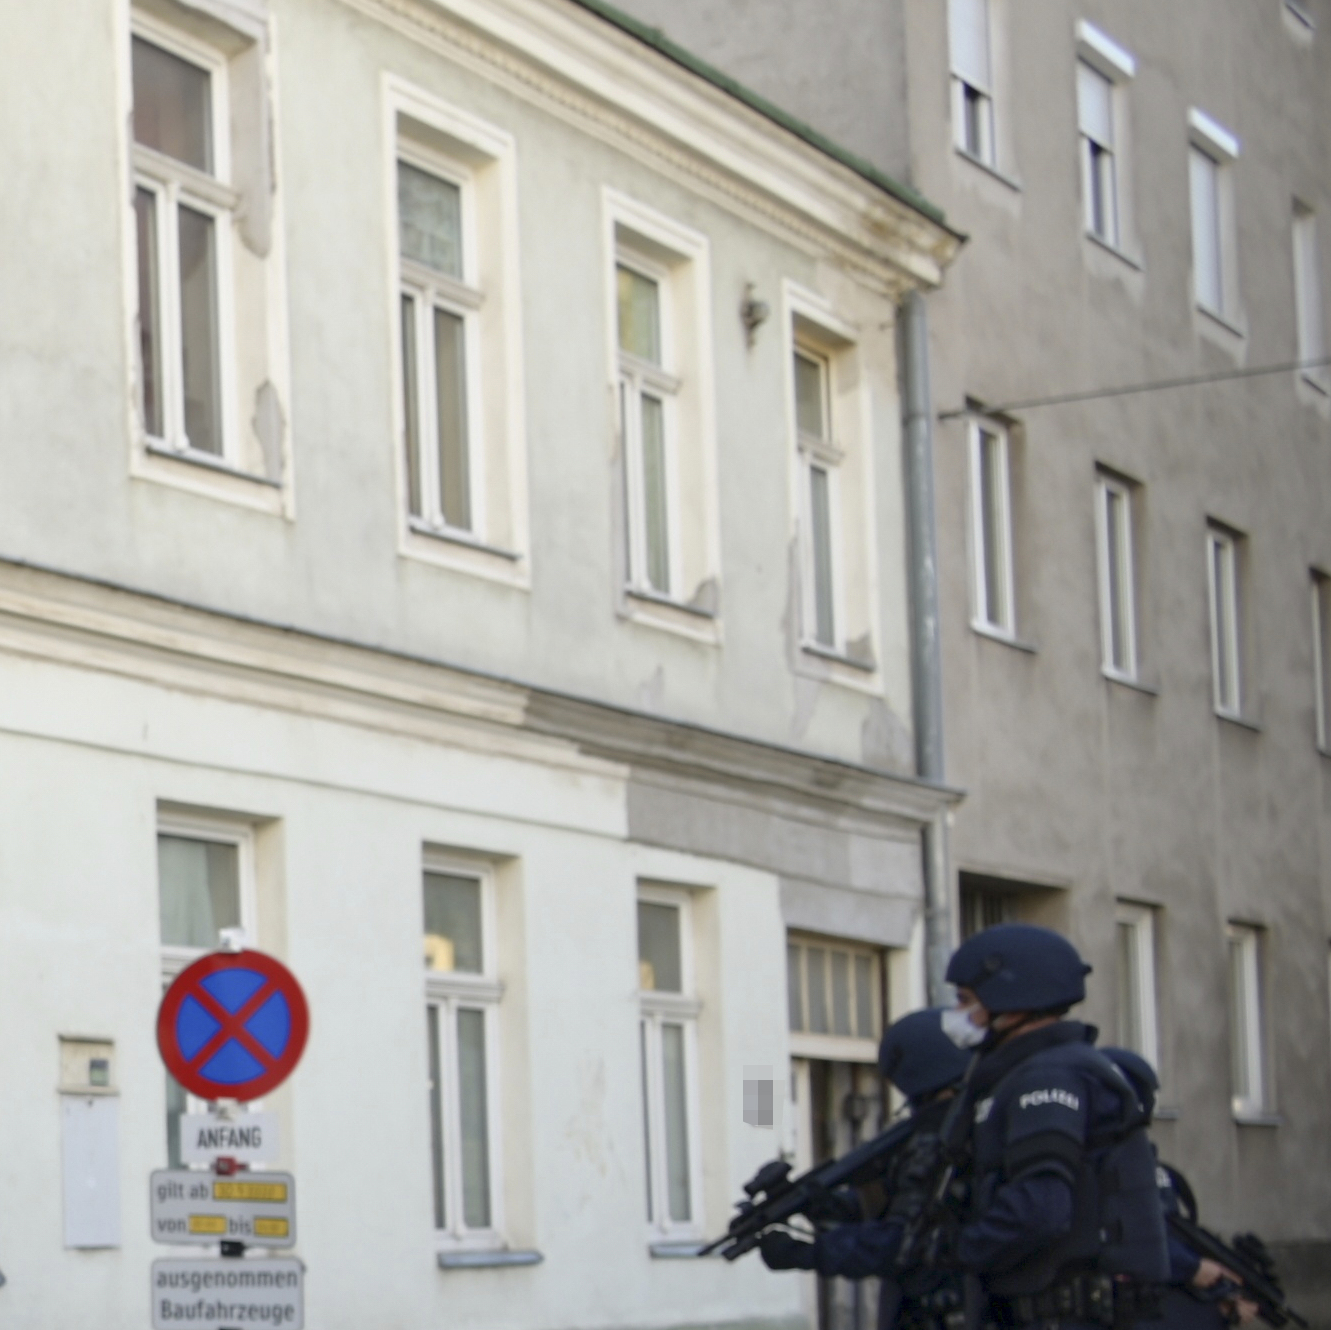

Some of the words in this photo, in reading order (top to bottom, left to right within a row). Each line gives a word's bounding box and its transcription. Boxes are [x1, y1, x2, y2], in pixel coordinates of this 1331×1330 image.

[196, 1126, 262, 1150] ANFANG
[156, 1180, 185, 1203] gilt
[190, 1182, 210, 1199] ab
[156, 1218, 186, 1233] von
[228, 1217, 252, 1234] bis
[156, 1270, 298, 1293] ausgenommen
[160, 1299, 295, 1327] Baufahrzeuge
